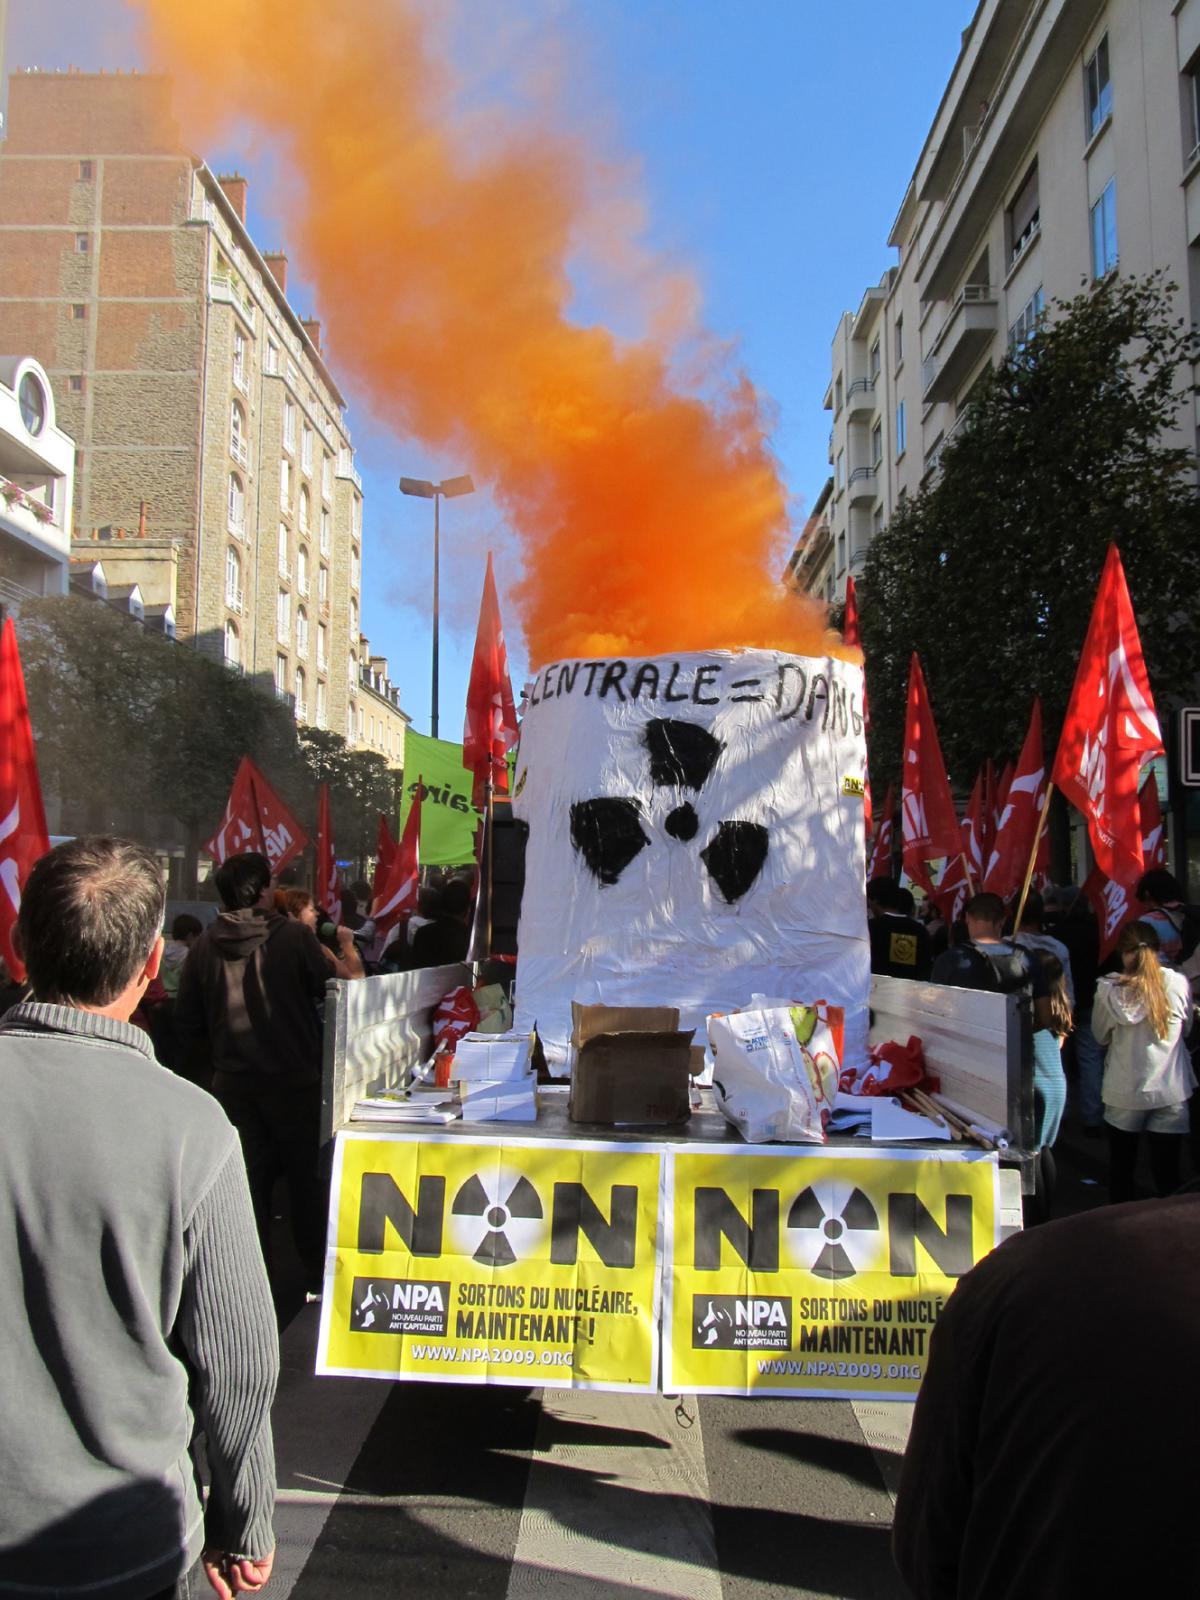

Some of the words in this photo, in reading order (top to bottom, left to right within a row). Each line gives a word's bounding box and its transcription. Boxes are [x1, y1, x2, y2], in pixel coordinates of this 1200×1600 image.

[530, 660, 722, 706] CENTRALE
[392, 1283, 445, 1311] NPA
[458, 1283, 525, 1307] SORTONS
[530, 1286, 548, 1308] DU
[554, 1285, 638, 1315] NUCLÉAIRE,
[800, 1297, 868, 1321] SORTONS
[873, 1299, 893, 1322] DU
[391, 1313, 424, 1322] NOUVEAU
[424, 1314, 443, 1323] PARTI
[735, 1300, 788, 1326] NPA
[389, 1322, 444, 1331] ANTICAPITALISTE
[456, 1310, 579, 1344] MAINTENANT
[735, 1329, 767, 1337] NOUVEAU
[768, 1330, 787, 1338] PARTI
[733, 1338, 788, 1346] ANTICAPITALISTE
[800, 1326, 925, 1356] MAINTENANT
[411, 1343, 575, 1367] WWW.NPA2009.ORG
[757, 1360, 922, 1380] WWW.NPA2009.ORG
